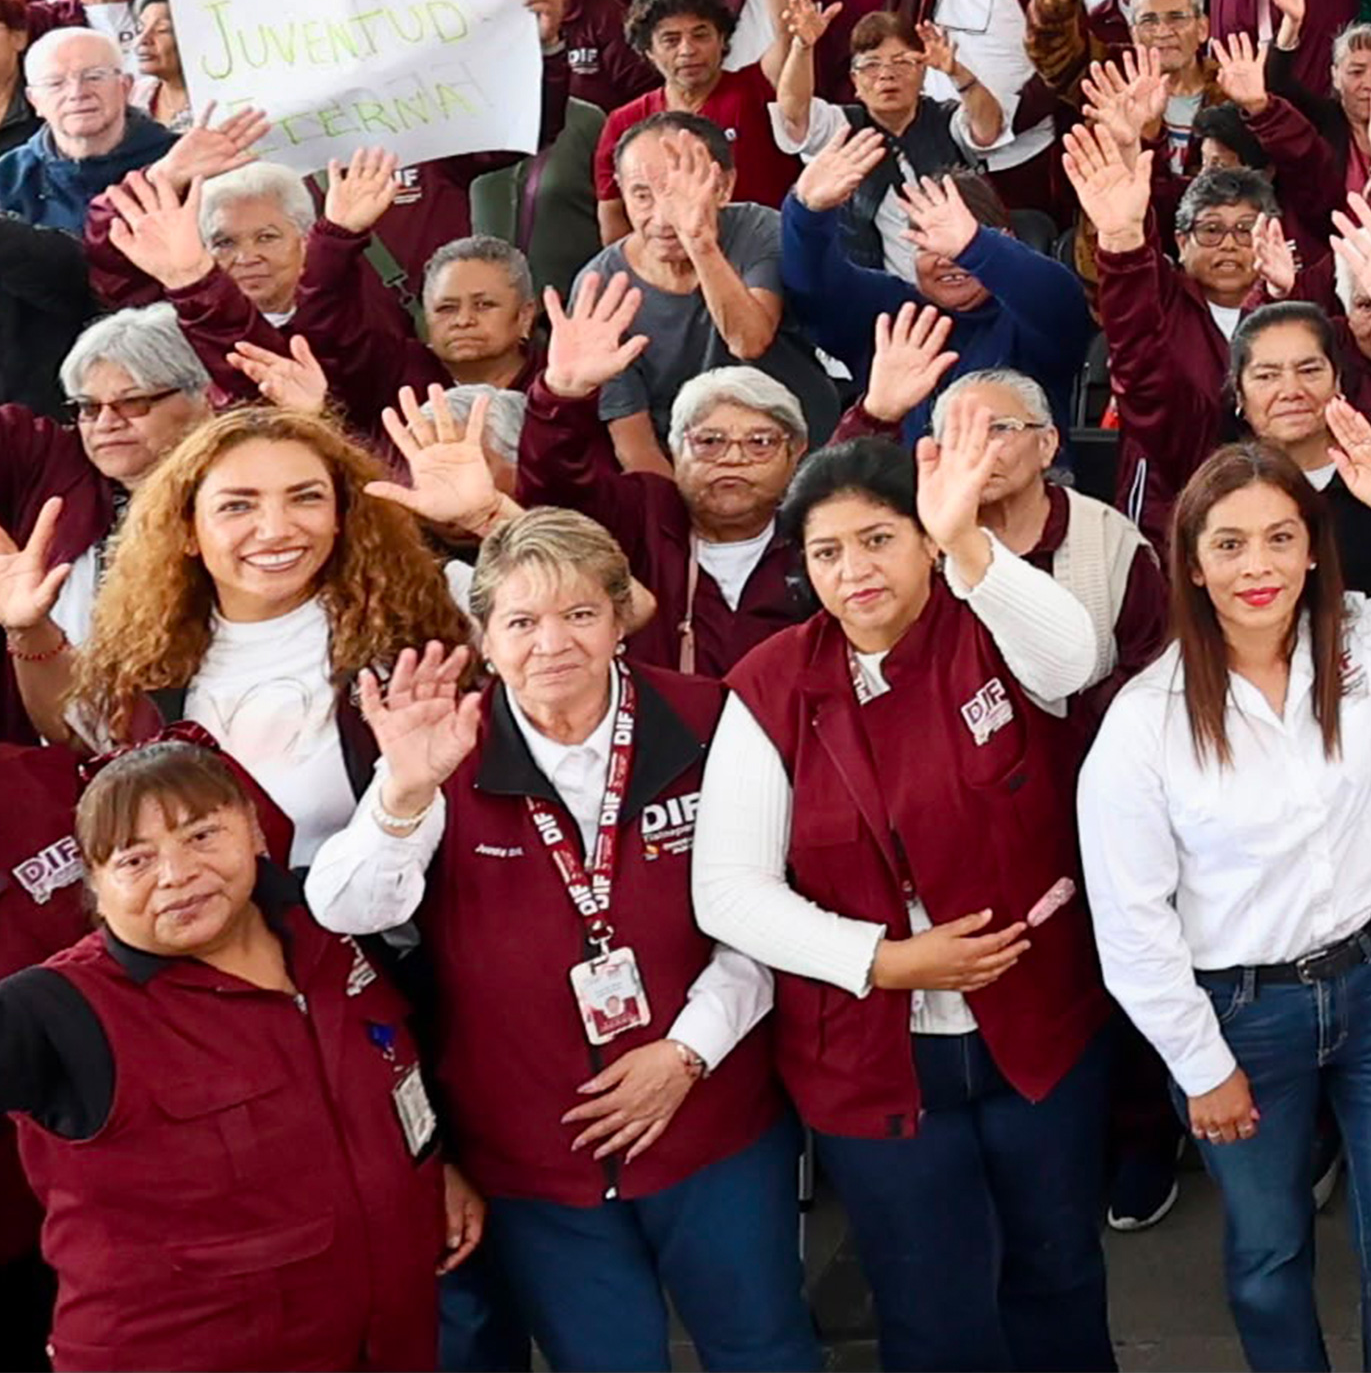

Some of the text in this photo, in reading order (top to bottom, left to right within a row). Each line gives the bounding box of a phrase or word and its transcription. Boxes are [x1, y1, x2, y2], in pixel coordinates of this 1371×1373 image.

[200, 0, 469, 81] JUVENTUD
[568, 47, 599, 64] DIF
[965, 680, 1002, 725] DIF
[614, 711, 633, 746] DIF
[601, 790, 622, 826] DIF
[641, 792, 701, 834] DIF
[534, 811, 563, 845] DIF
[24, 837, 81, 886] DIF
[568, 885, 599, 917] DIF
